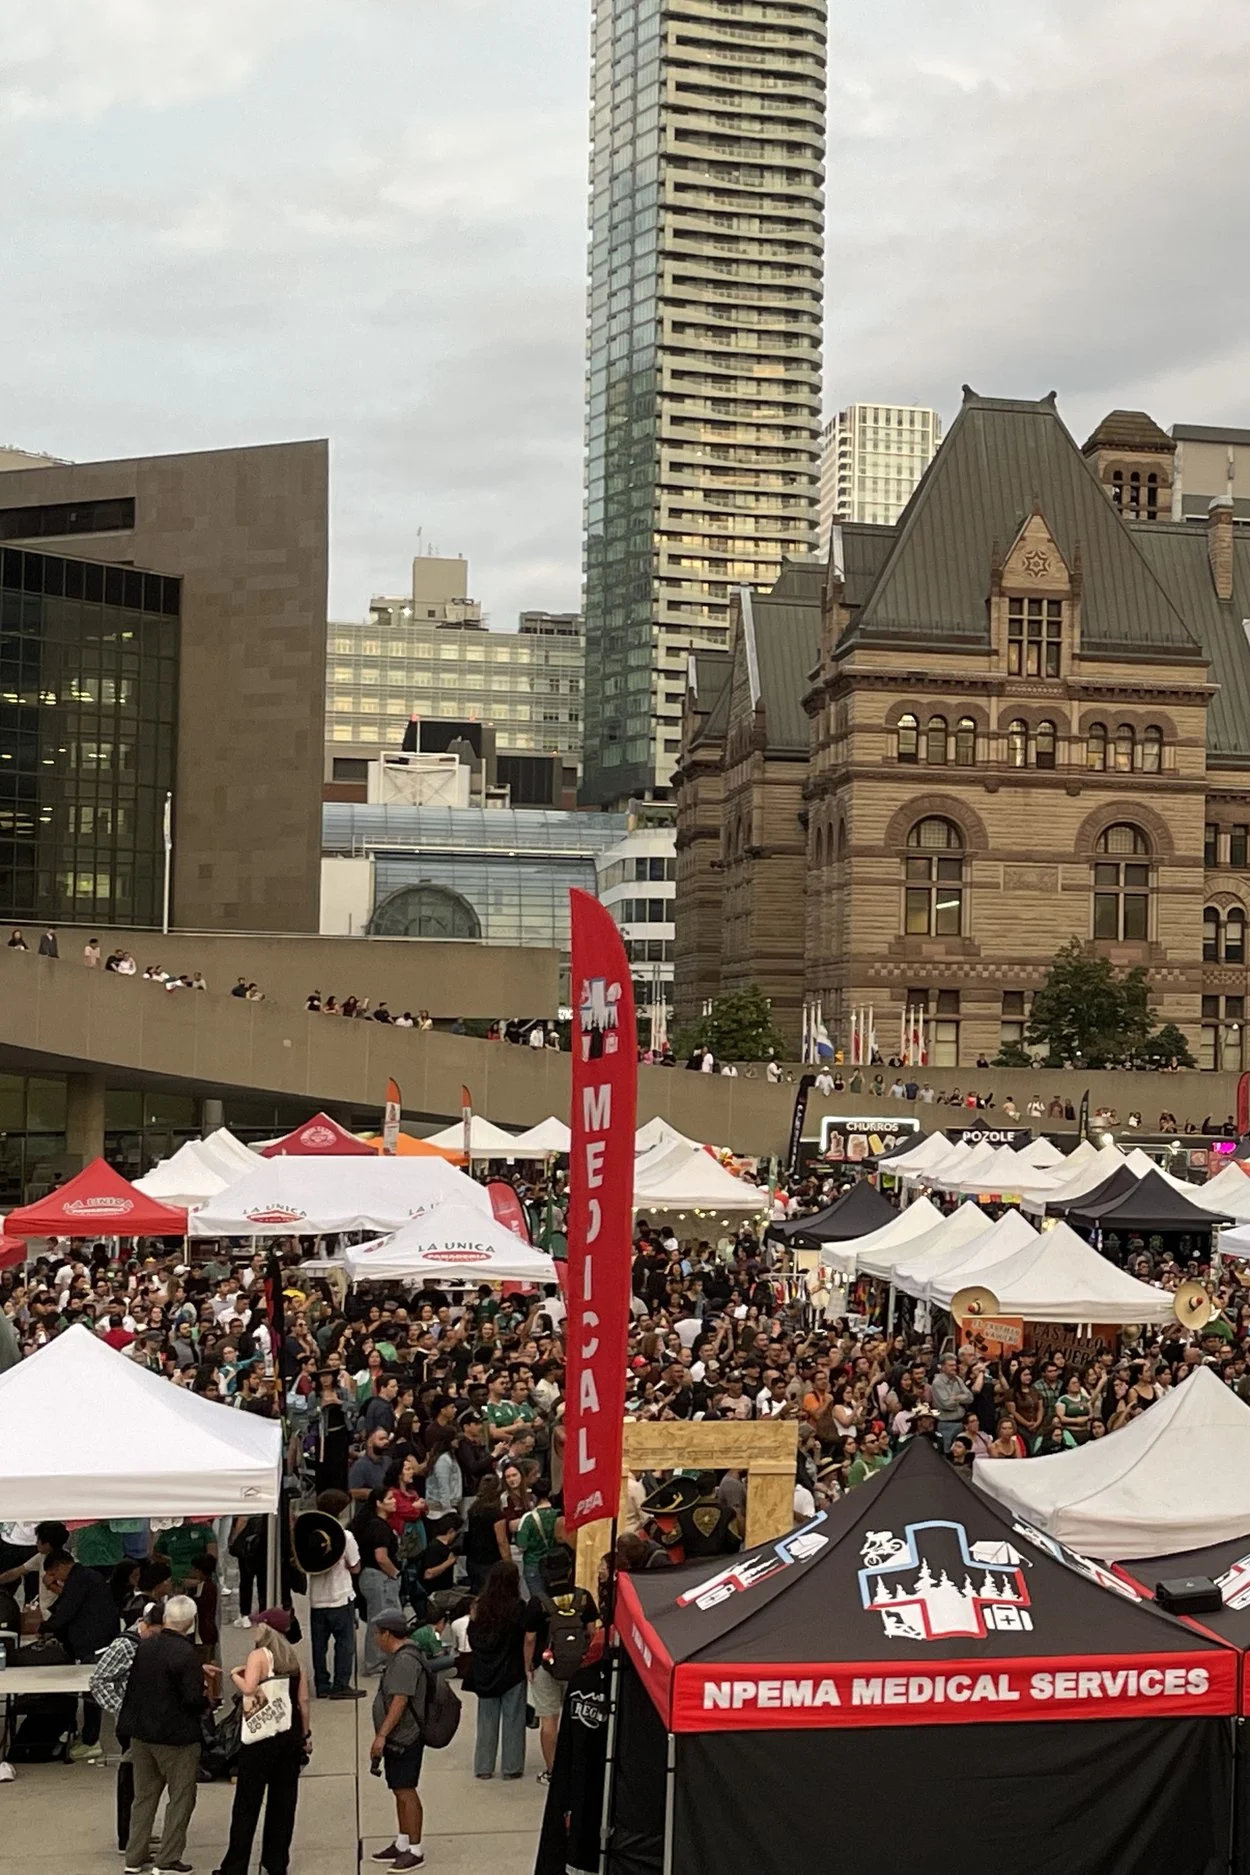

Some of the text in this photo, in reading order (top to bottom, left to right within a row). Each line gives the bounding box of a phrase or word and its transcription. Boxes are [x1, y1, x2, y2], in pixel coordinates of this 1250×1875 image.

[846, 1121, 899, 1133] CHURROS
[962, 1131, 1015, 1142] POZOLE
[266, 1203, 307, 1217] UNICA
[418, 1242, 496, 1253] LA UNICA
[579, 1084, 612, 1475] MEDICAL
[703, 1668, 1210, 1710] NPEMA MEDICAL SERVICES
